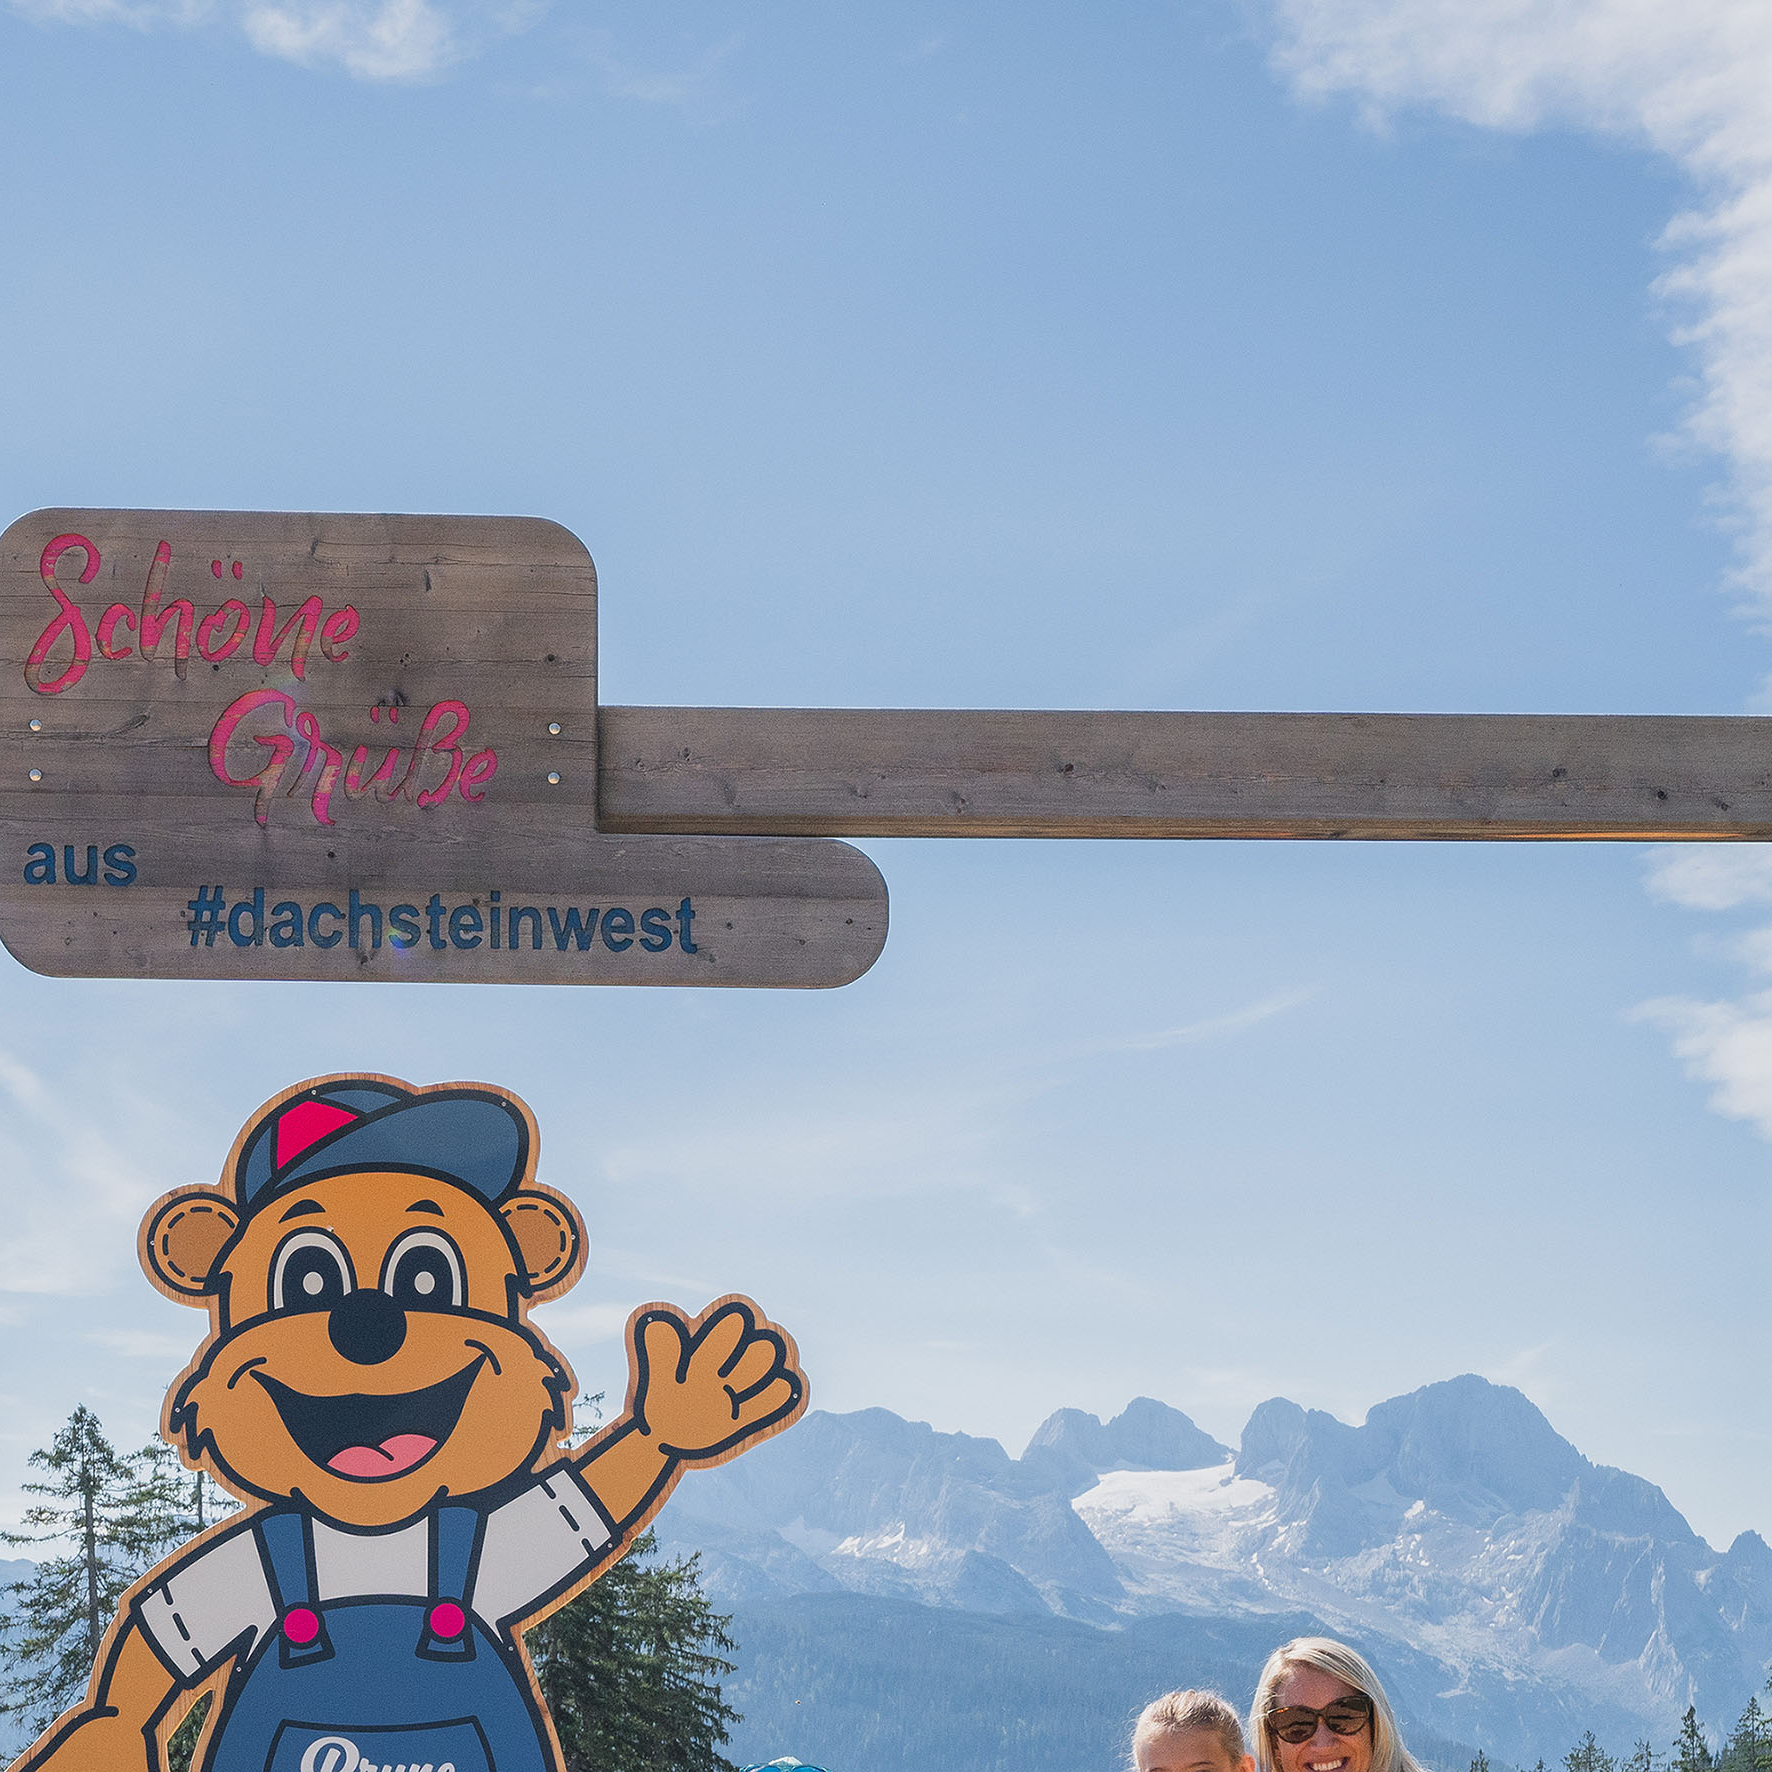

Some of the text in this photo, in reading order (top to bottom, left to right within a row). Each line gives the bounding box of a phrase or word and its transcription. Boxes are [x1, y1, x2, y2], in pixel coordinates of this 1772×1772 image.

[24, 533, 361, 694] Schöne
[208, 688, 499, 828] Grüße
[22, 841, 138, 886] aus
[186, 884, 699, 955] #dachsteinwest
